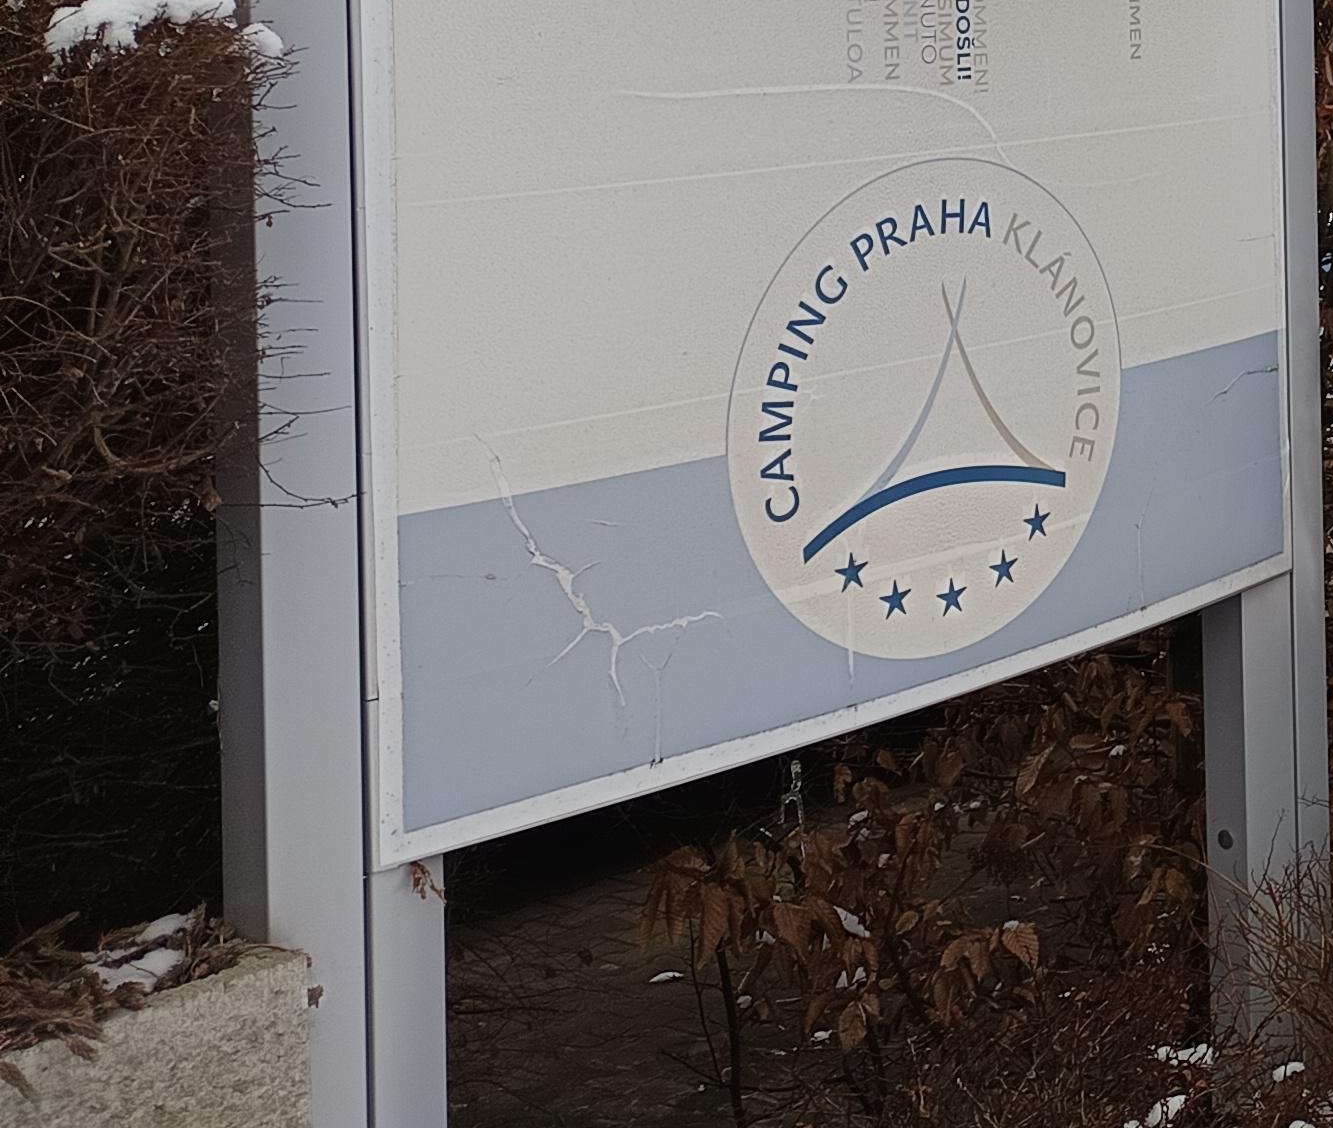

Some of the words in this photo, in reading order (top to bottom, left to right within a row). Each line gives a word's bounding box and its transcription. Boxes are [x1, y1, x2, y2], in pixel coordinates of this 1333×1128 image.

[758, 265, 849, 523] CAMPING
[849, 198, 993, 272] PRAHA
[1002, 212, 1103, 462] KLÁNOVICE
